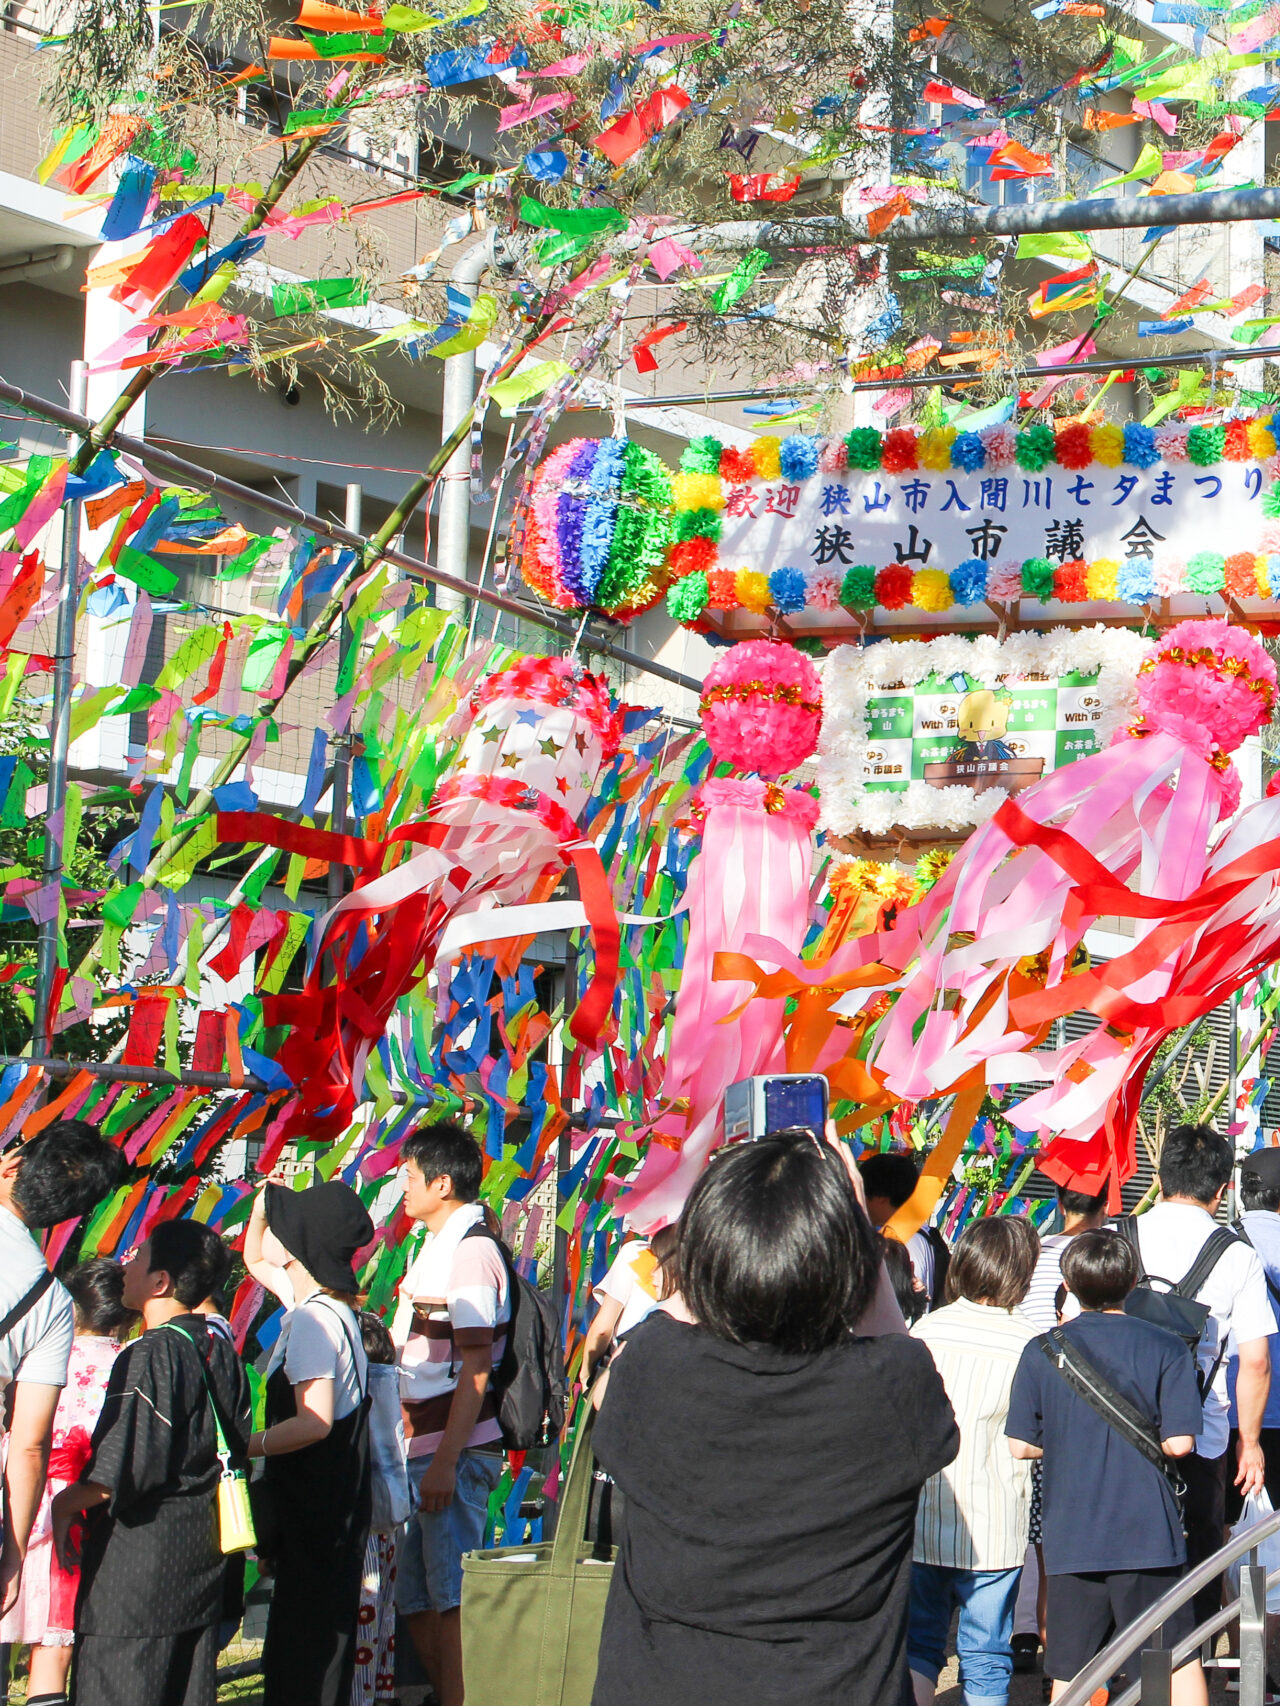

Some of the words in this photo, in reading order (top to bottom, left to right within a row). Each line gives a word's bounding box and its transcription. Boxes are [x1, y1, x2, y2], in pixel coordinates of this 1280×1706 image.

[724, 483, 801, 520] 歓迎
[819, 467, 1264, 514] 狭山市入間川七夕まつり
[811, 515, 1166, 565] 狭山市議会
[956, 762, 1009, 774] 狭山市議会
